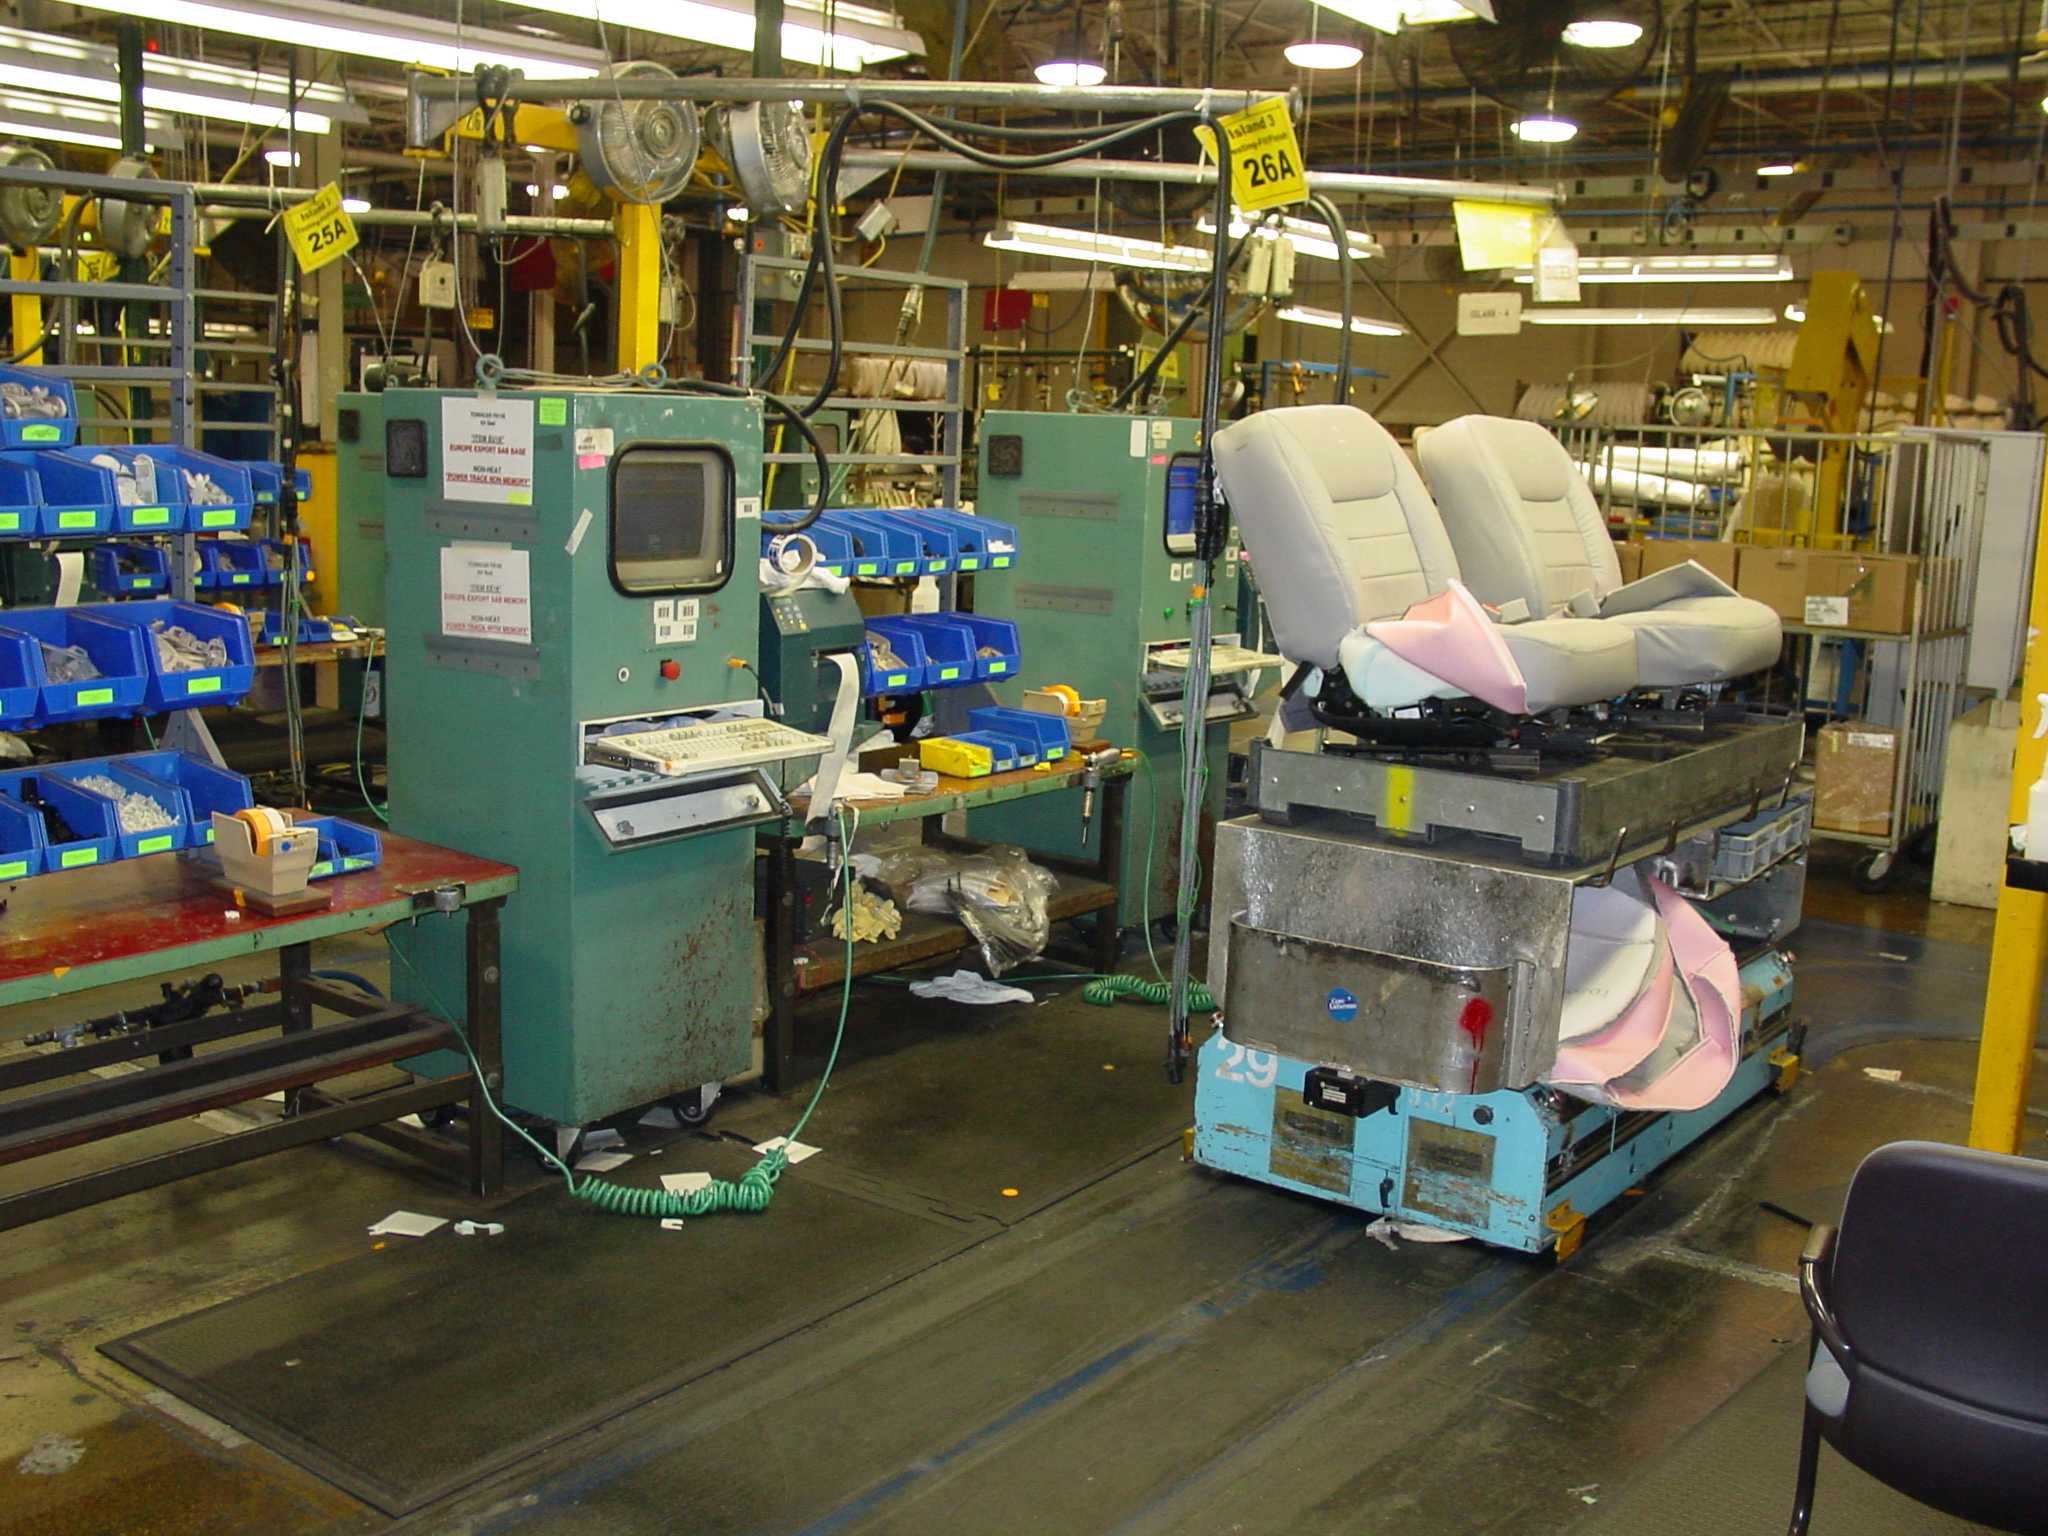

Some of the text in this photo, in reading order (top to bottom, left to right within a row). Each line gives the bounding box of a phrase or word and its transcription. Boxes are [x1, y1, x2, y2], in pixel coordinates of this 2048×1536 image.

[1227, 114, 1275, 139] Island 3
[1243, 149, 1296, 188] 26A
[301, 201, 326, 221] Island
[308, 219, 347, 253] 25A
[450, 444, 472, 453] EUROPE
[474, 445, 496, 454] EXPORT
[510, 447, 526, 456] BASE
[469, 473, 488, 482] TRACK
[473, 465, 502, 474] NON-HEAT
[444, 593, 466, 602] EUROPE
[467, 594, 489, 603] EXPORT
[471, 614, 500, 623] NON-HEAT
[1215, 1038, 1278, 1088] 29
